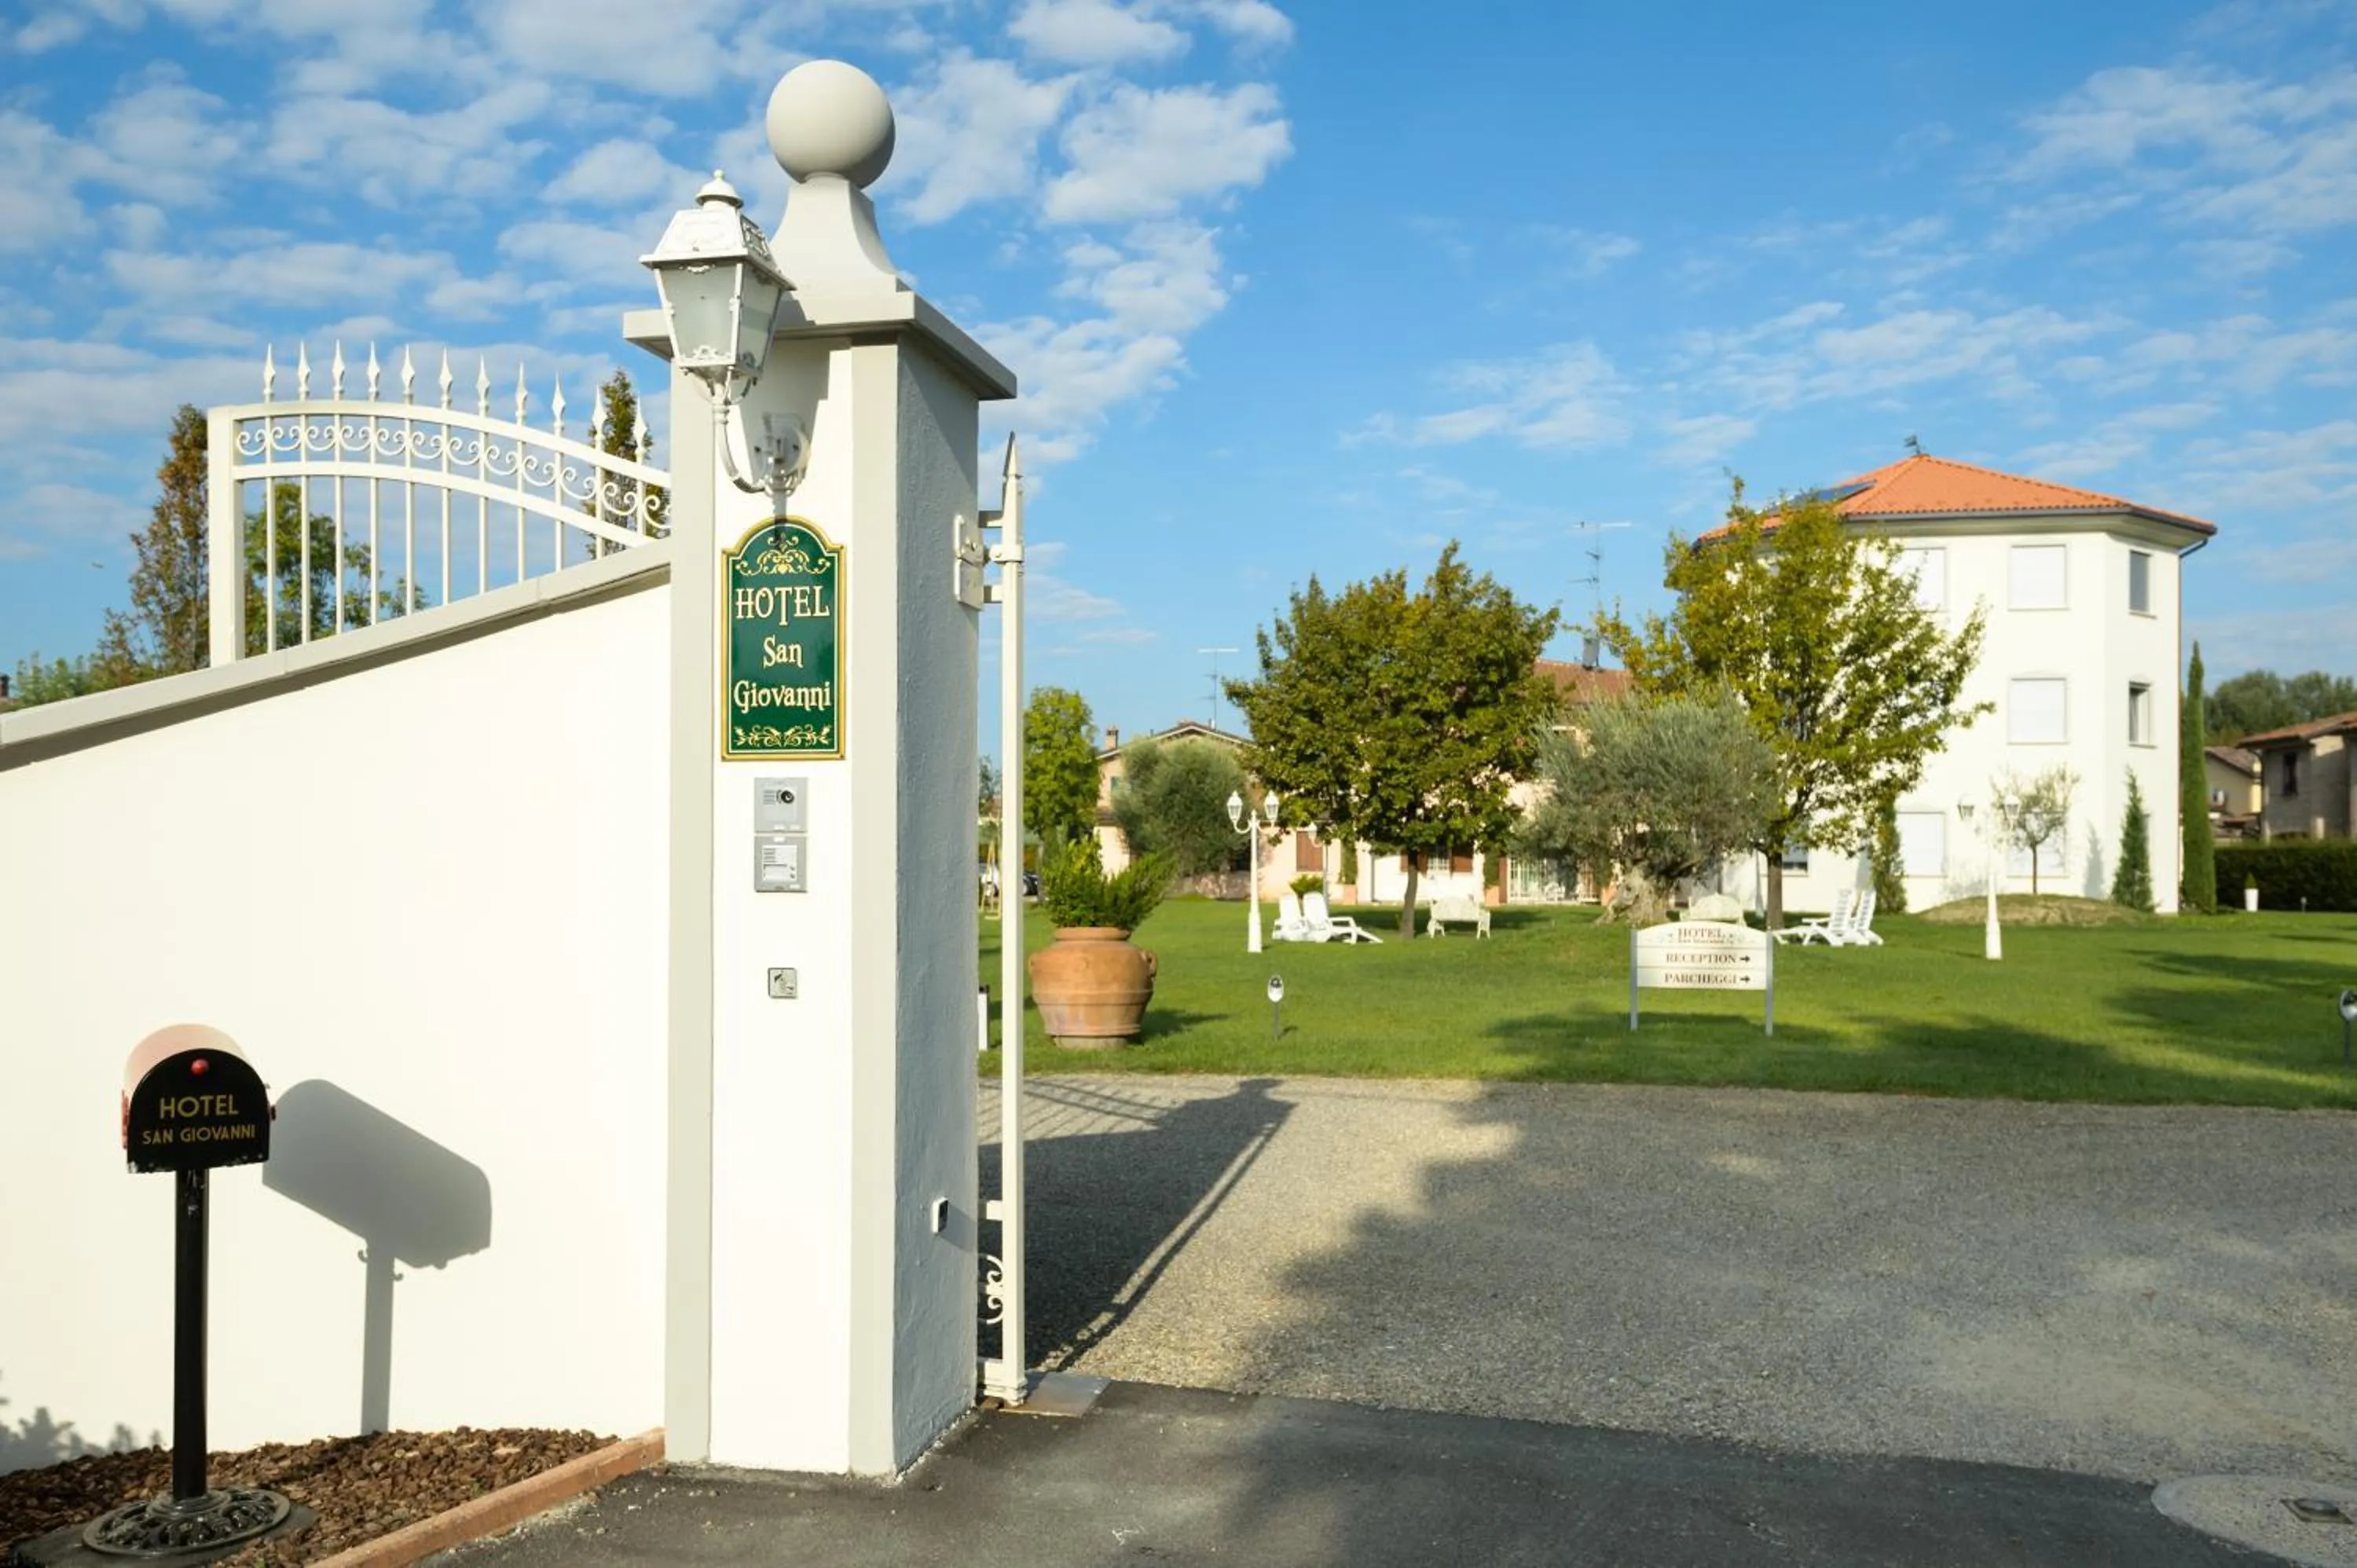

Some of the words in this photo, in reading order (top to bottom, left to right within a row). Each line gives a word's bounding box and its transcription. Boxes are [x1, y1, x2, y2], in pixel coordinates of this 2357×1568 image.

[735, 586, 830, 625] HOTEL
[763, 635, 803, 669] San
[733, 680, 831, 713] Giovanni
[1677, 928, 1726, 938] HOTEL
[1666, 953, 1737, 964] RECEPTION
[1664, 973, 1737, 984] PARCHEGGI
[159, 1094, 239, 1119] HOTEL
[142, 1129, 174, 1145] SAN
[180, 1124, 255, 1141] GIOVANNI
